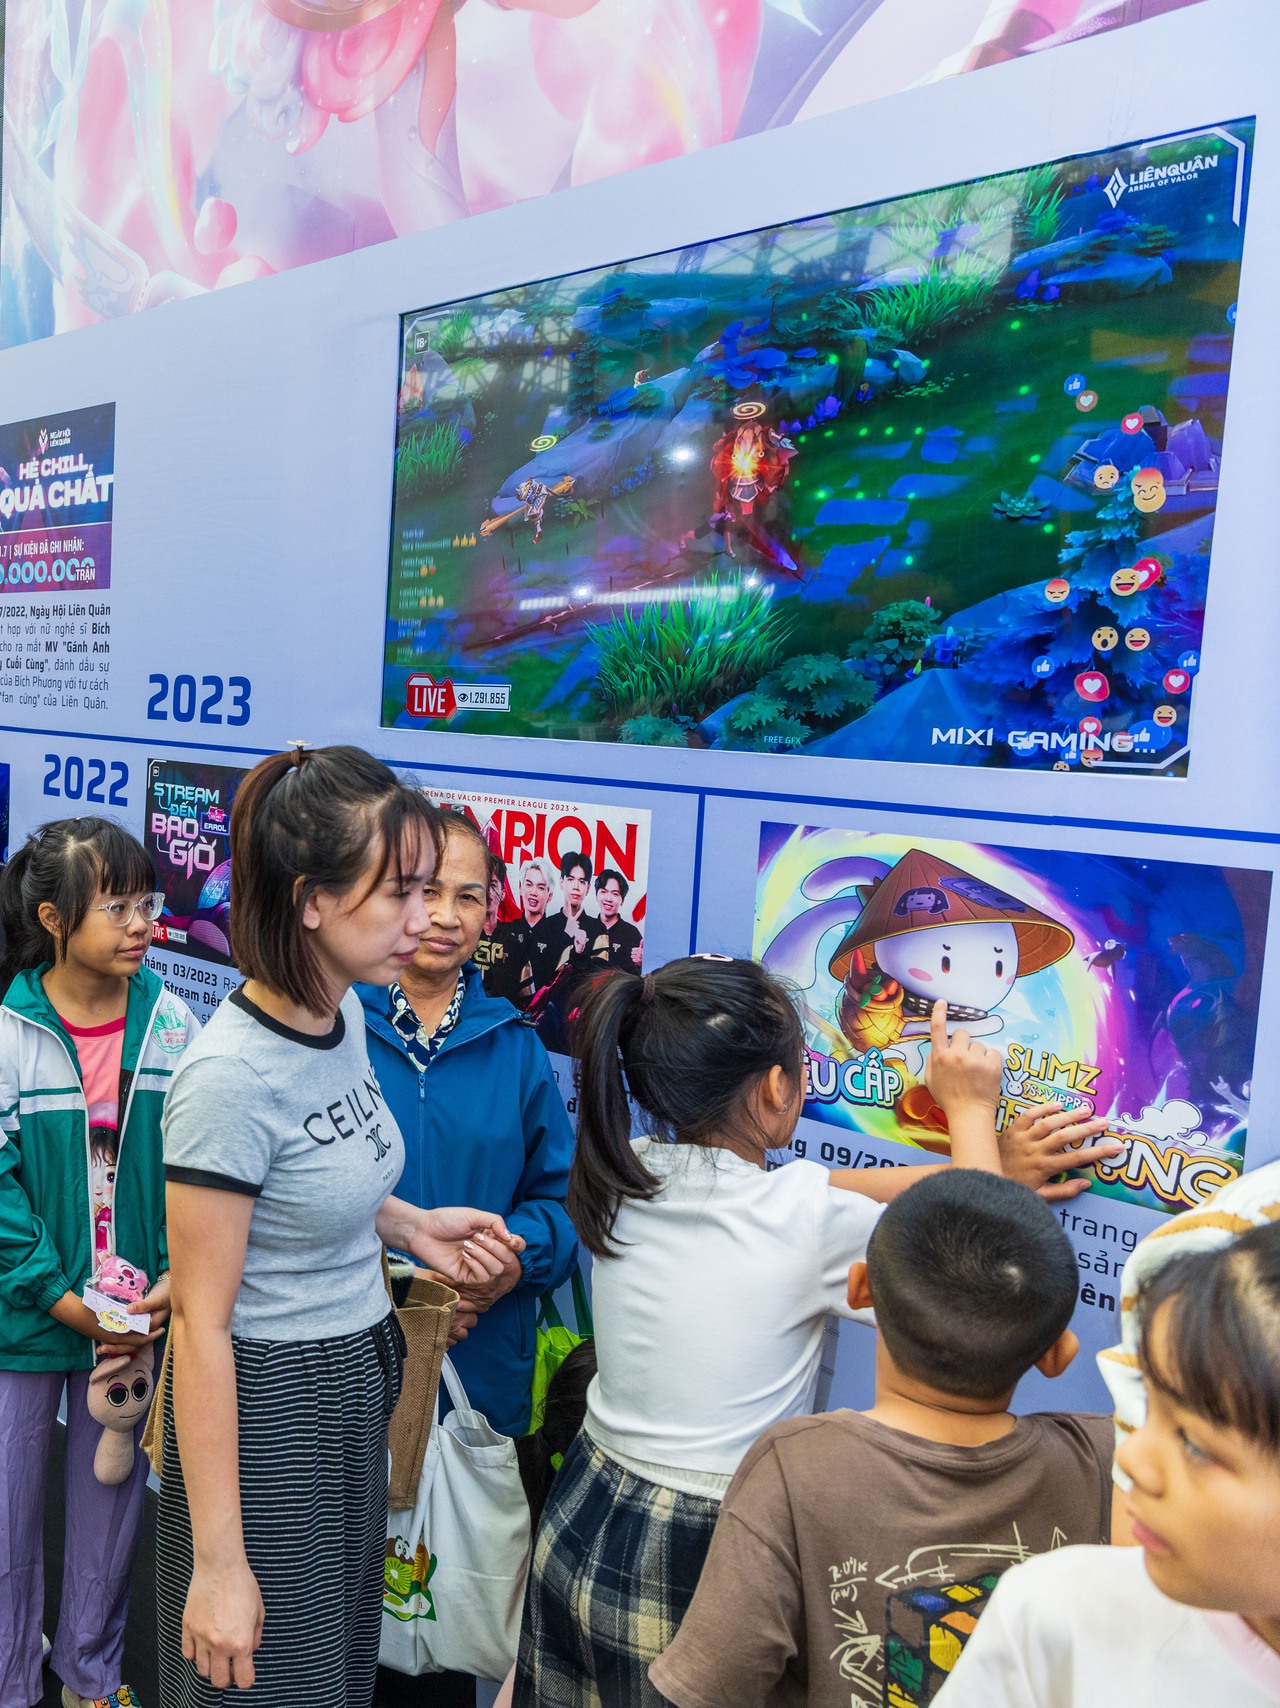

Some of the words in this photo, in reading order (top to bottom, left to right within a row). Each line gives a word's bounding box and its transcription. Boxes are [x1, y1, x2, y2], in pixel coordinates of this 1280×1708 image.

[1128, 182, 1156, 194] ARENA
[1157, 178, 1169, 187] OF
[1170, 172, 1199, 184] VALOR
[40, 453, 94, 477] CHILL,
[48, 470, 114, 509] CHẤT
[24, 541, 38, 560] KIỆN
[39, 538, 49, 554] ĐÁ
[49, 540, 62, 554] GHI
[63, 536, 85, 553] NHẬN:
[75, 566, 96, 583] TRẬN
[30, 604, 50, 619] Ngày
[52, 603, 66, 619] Hội
[68, 604, 86, 617] Liên
[88, 603, 111, 617] Quân
[7, 623, 21, 637] hợp
[25, 623, 36, 635] với
[40, 623, 50, 635] nữ
[55, 622, 75, 638] nghệ
[91, 622, 110, 635] Bích
[0, 640, 12, 652] cho
[15, 643, 23, 652] ra
[26, 638, 41, 652] mắt
[45, 641, 59, 653] MV
[92, 641, 110, 653] Anh
[6, 655, 22, 669] Cuối
[54, 659, 75, 671] đánh
[78, 656, 95, 672] dấu
[99, 661, 110, 675] sự
[14, 675, 30, 687] Bích
[32, 676, 62, 692] Phương
[65, 676, 76, 690] với
[89, 678, 109, 691] cách
[43, 693, 57, 706] của
[61, 694, 79, 708] Liên
[83, 695, 109, 710] Quân.
[146, 673, 252, 727] 2023
[414, 687, 447, 713] LIVE
[469, 692, 506, 705] 1.291.855
[763, 735, 783, 744] FREE
[785, 736, 801, 744] GFX
[931, 726, 994, 747] MIXI
[42, 753, 130, 807] 2022
[153, 782, 220, 806] STREAM
[457, 794, 482, 802] VALOR
[484, 796, 516, 806] PREMIER
[518, 799, 548, 809] LEAGUE
[550, 803, 570, 812] 2023
[170, 800, 198, 819] ĐẾN
[151, 812, 199, 845] BAO
[169, 835, 217, 881] GIỜ
[172, 959, 218, 987] 03/2023
[843, 1050, 901, 1102] CẤP
[1059, 1208, 1138, 1253] trang
